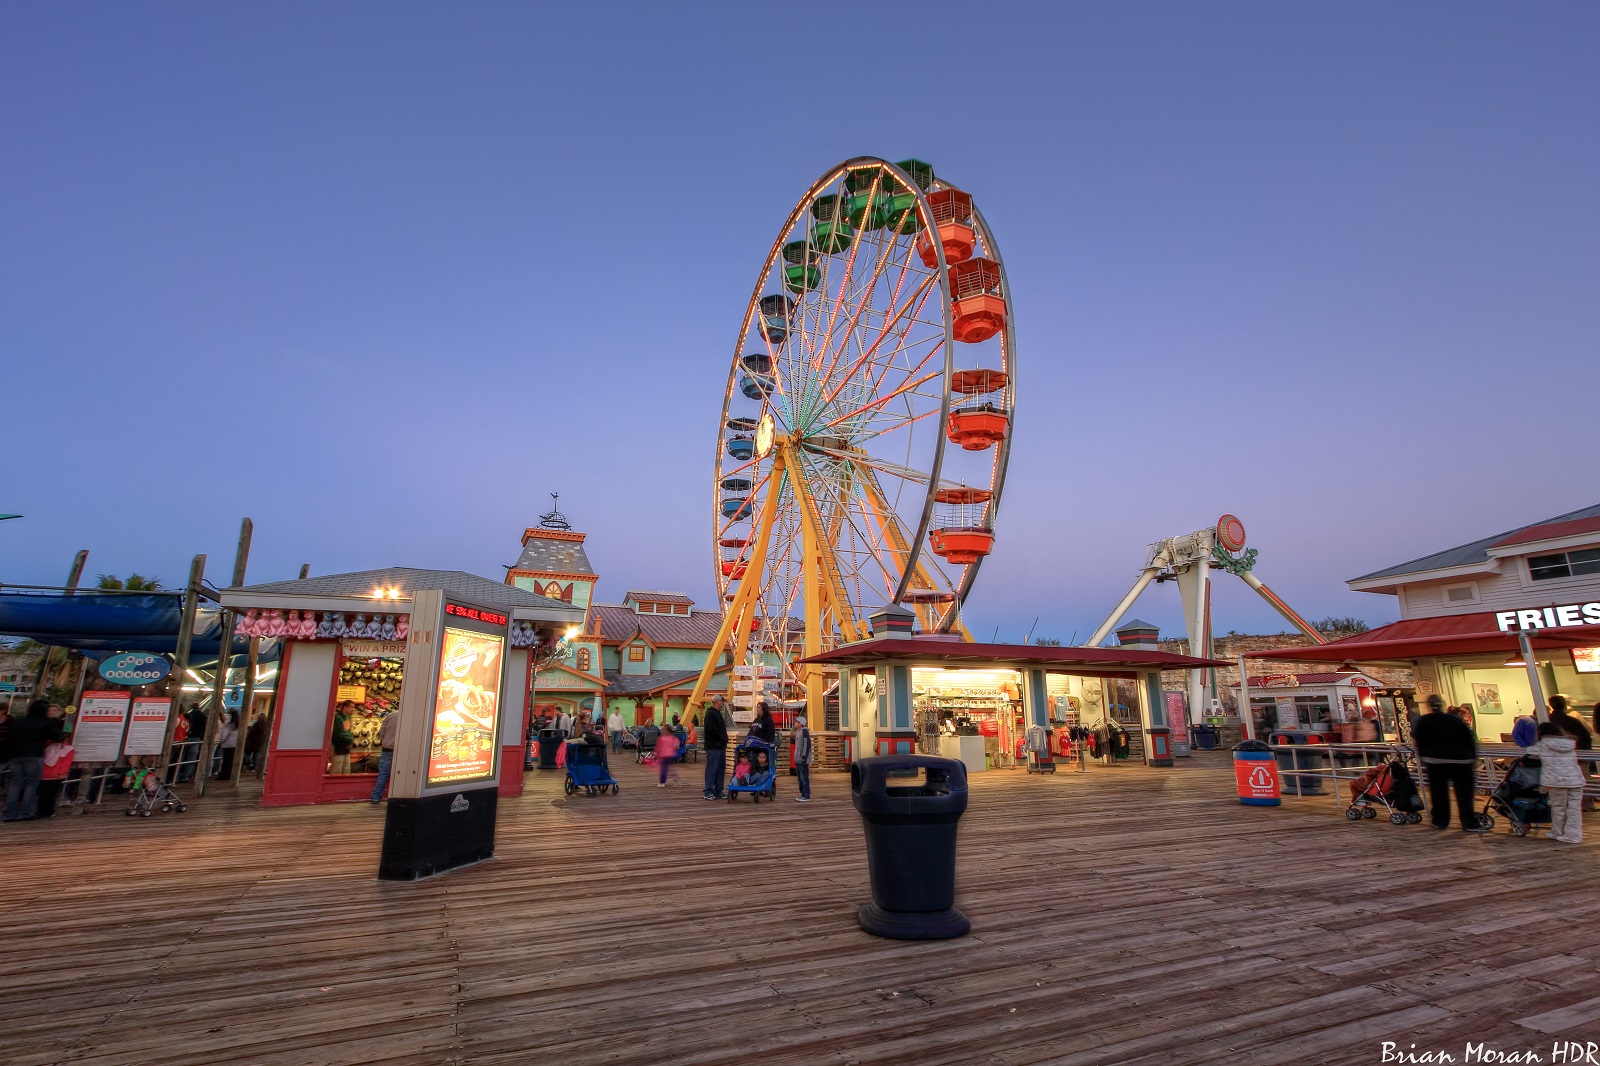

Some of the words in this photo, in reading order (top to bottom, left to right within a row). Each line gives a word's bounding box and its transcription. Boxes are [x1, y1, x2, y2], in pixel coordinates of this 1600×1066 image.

[1496, 602, 1600, 632] FRIES
[372, 645, 379, 653] A
[107, 671, 159, 679] RUNNER
